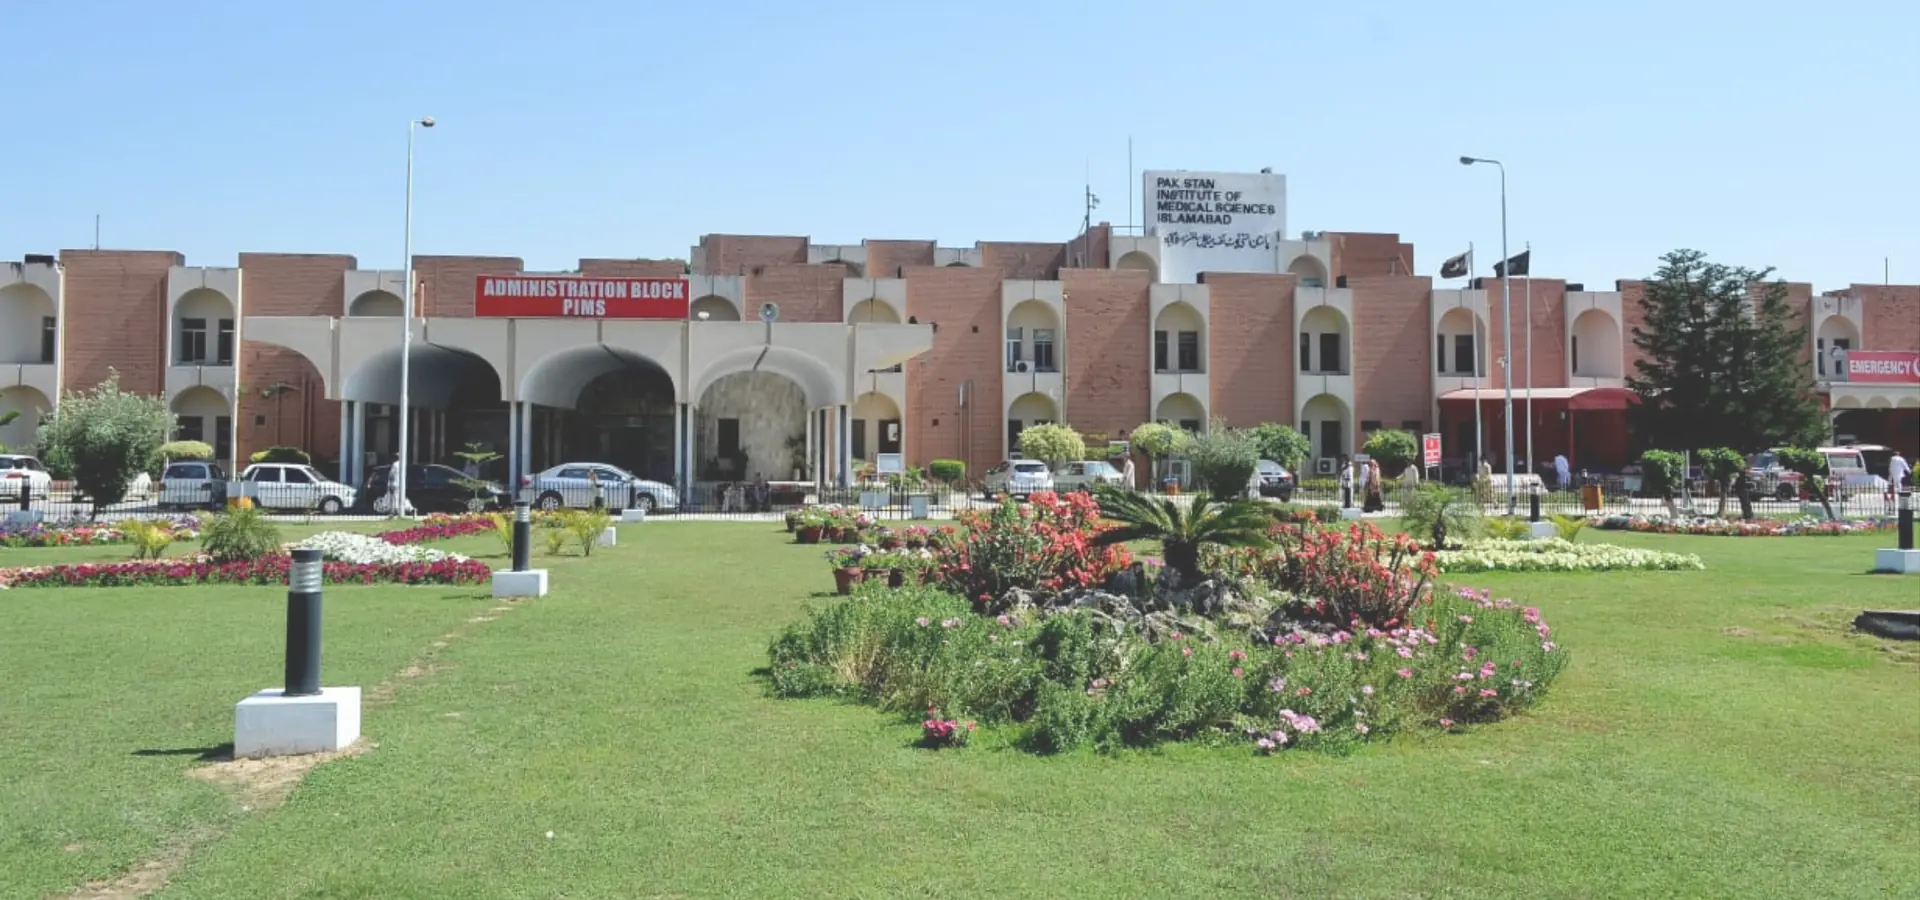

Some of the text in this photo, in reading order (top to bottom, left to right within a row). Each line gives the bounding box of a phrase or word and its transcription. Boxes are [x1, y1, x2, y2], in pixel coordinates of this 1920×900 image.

[1225, 192, 1241, 201] OF
[1157, 201, 1275, 215] MEDICAL SCIENCES
[1157, 213, 1231, 225] ISLAMABAD
[484, 279, 684, 299] ADMINISTRATION BLOCK
[563, 298, 606, 316] PIMS
[1850, 359, 1911, 375] EMERGENCY
